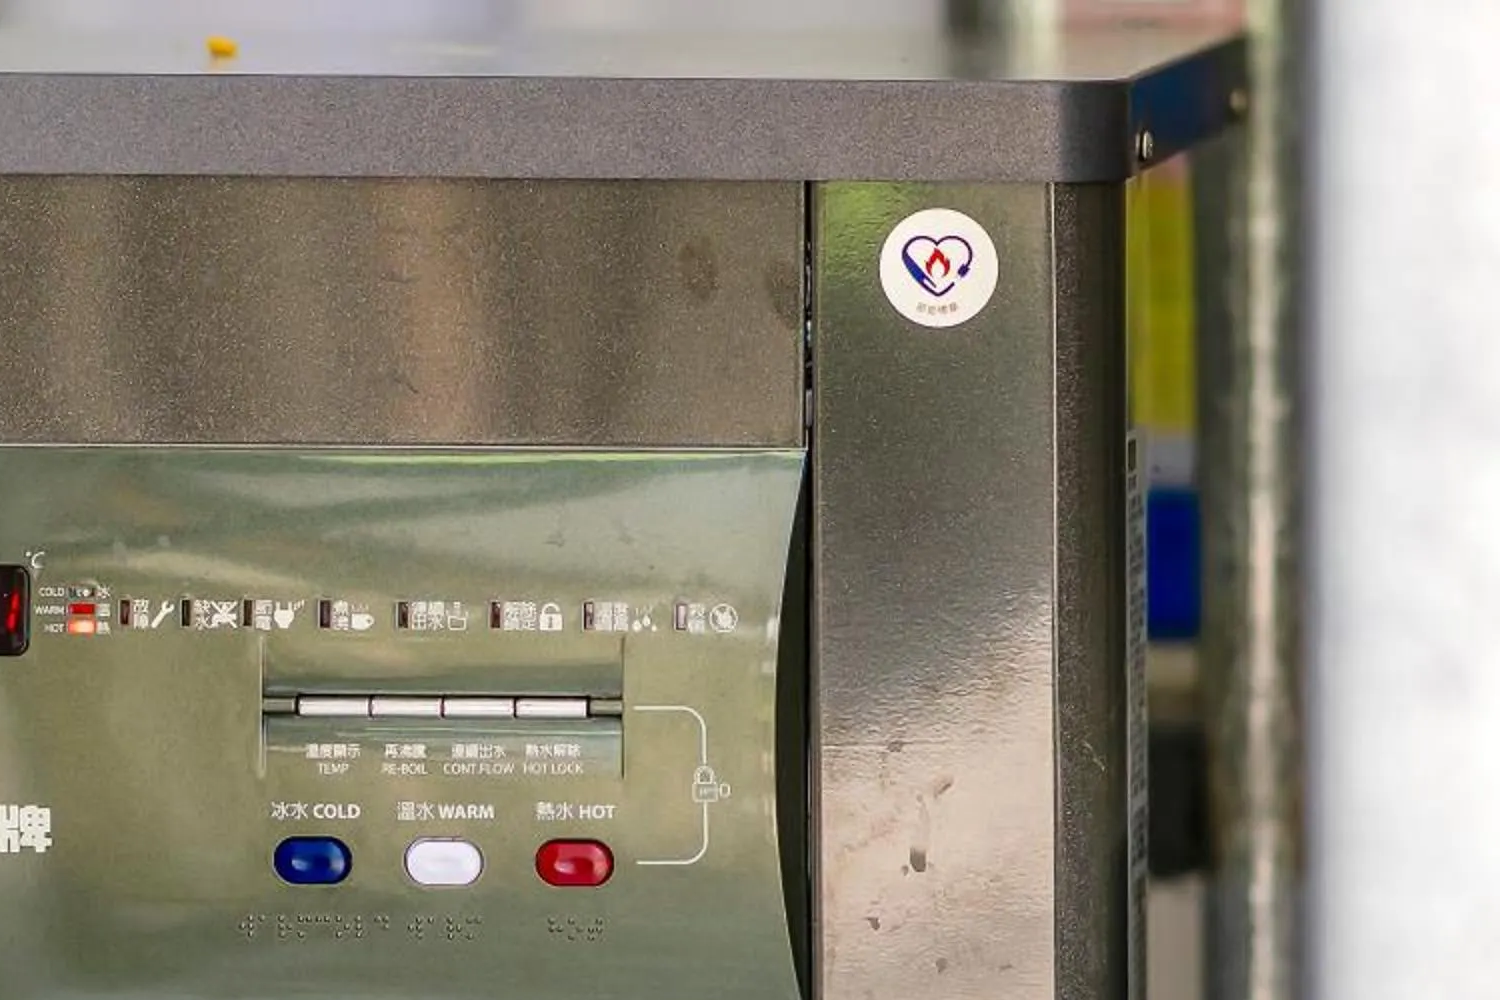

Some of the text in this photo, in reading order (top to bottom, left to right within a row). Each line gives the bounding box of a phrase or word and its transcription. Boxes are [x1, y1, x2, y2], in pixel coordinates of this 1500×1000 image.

[39, 586, 65, 597] COLD
[35, 604, 65, 616] WARM
[45, 623, 65, 634] HOT
[318, 763, 350, 775] TEMP
[381, 763, 429, 775] RE-BOIL
[522, 763, 584, 775] HOT LOCK
[271, 801, 361, 821] 冰水 COLD
[438, 804, 495, 819] WARM
[536, 801, 617, 821] 熱水 HOT
